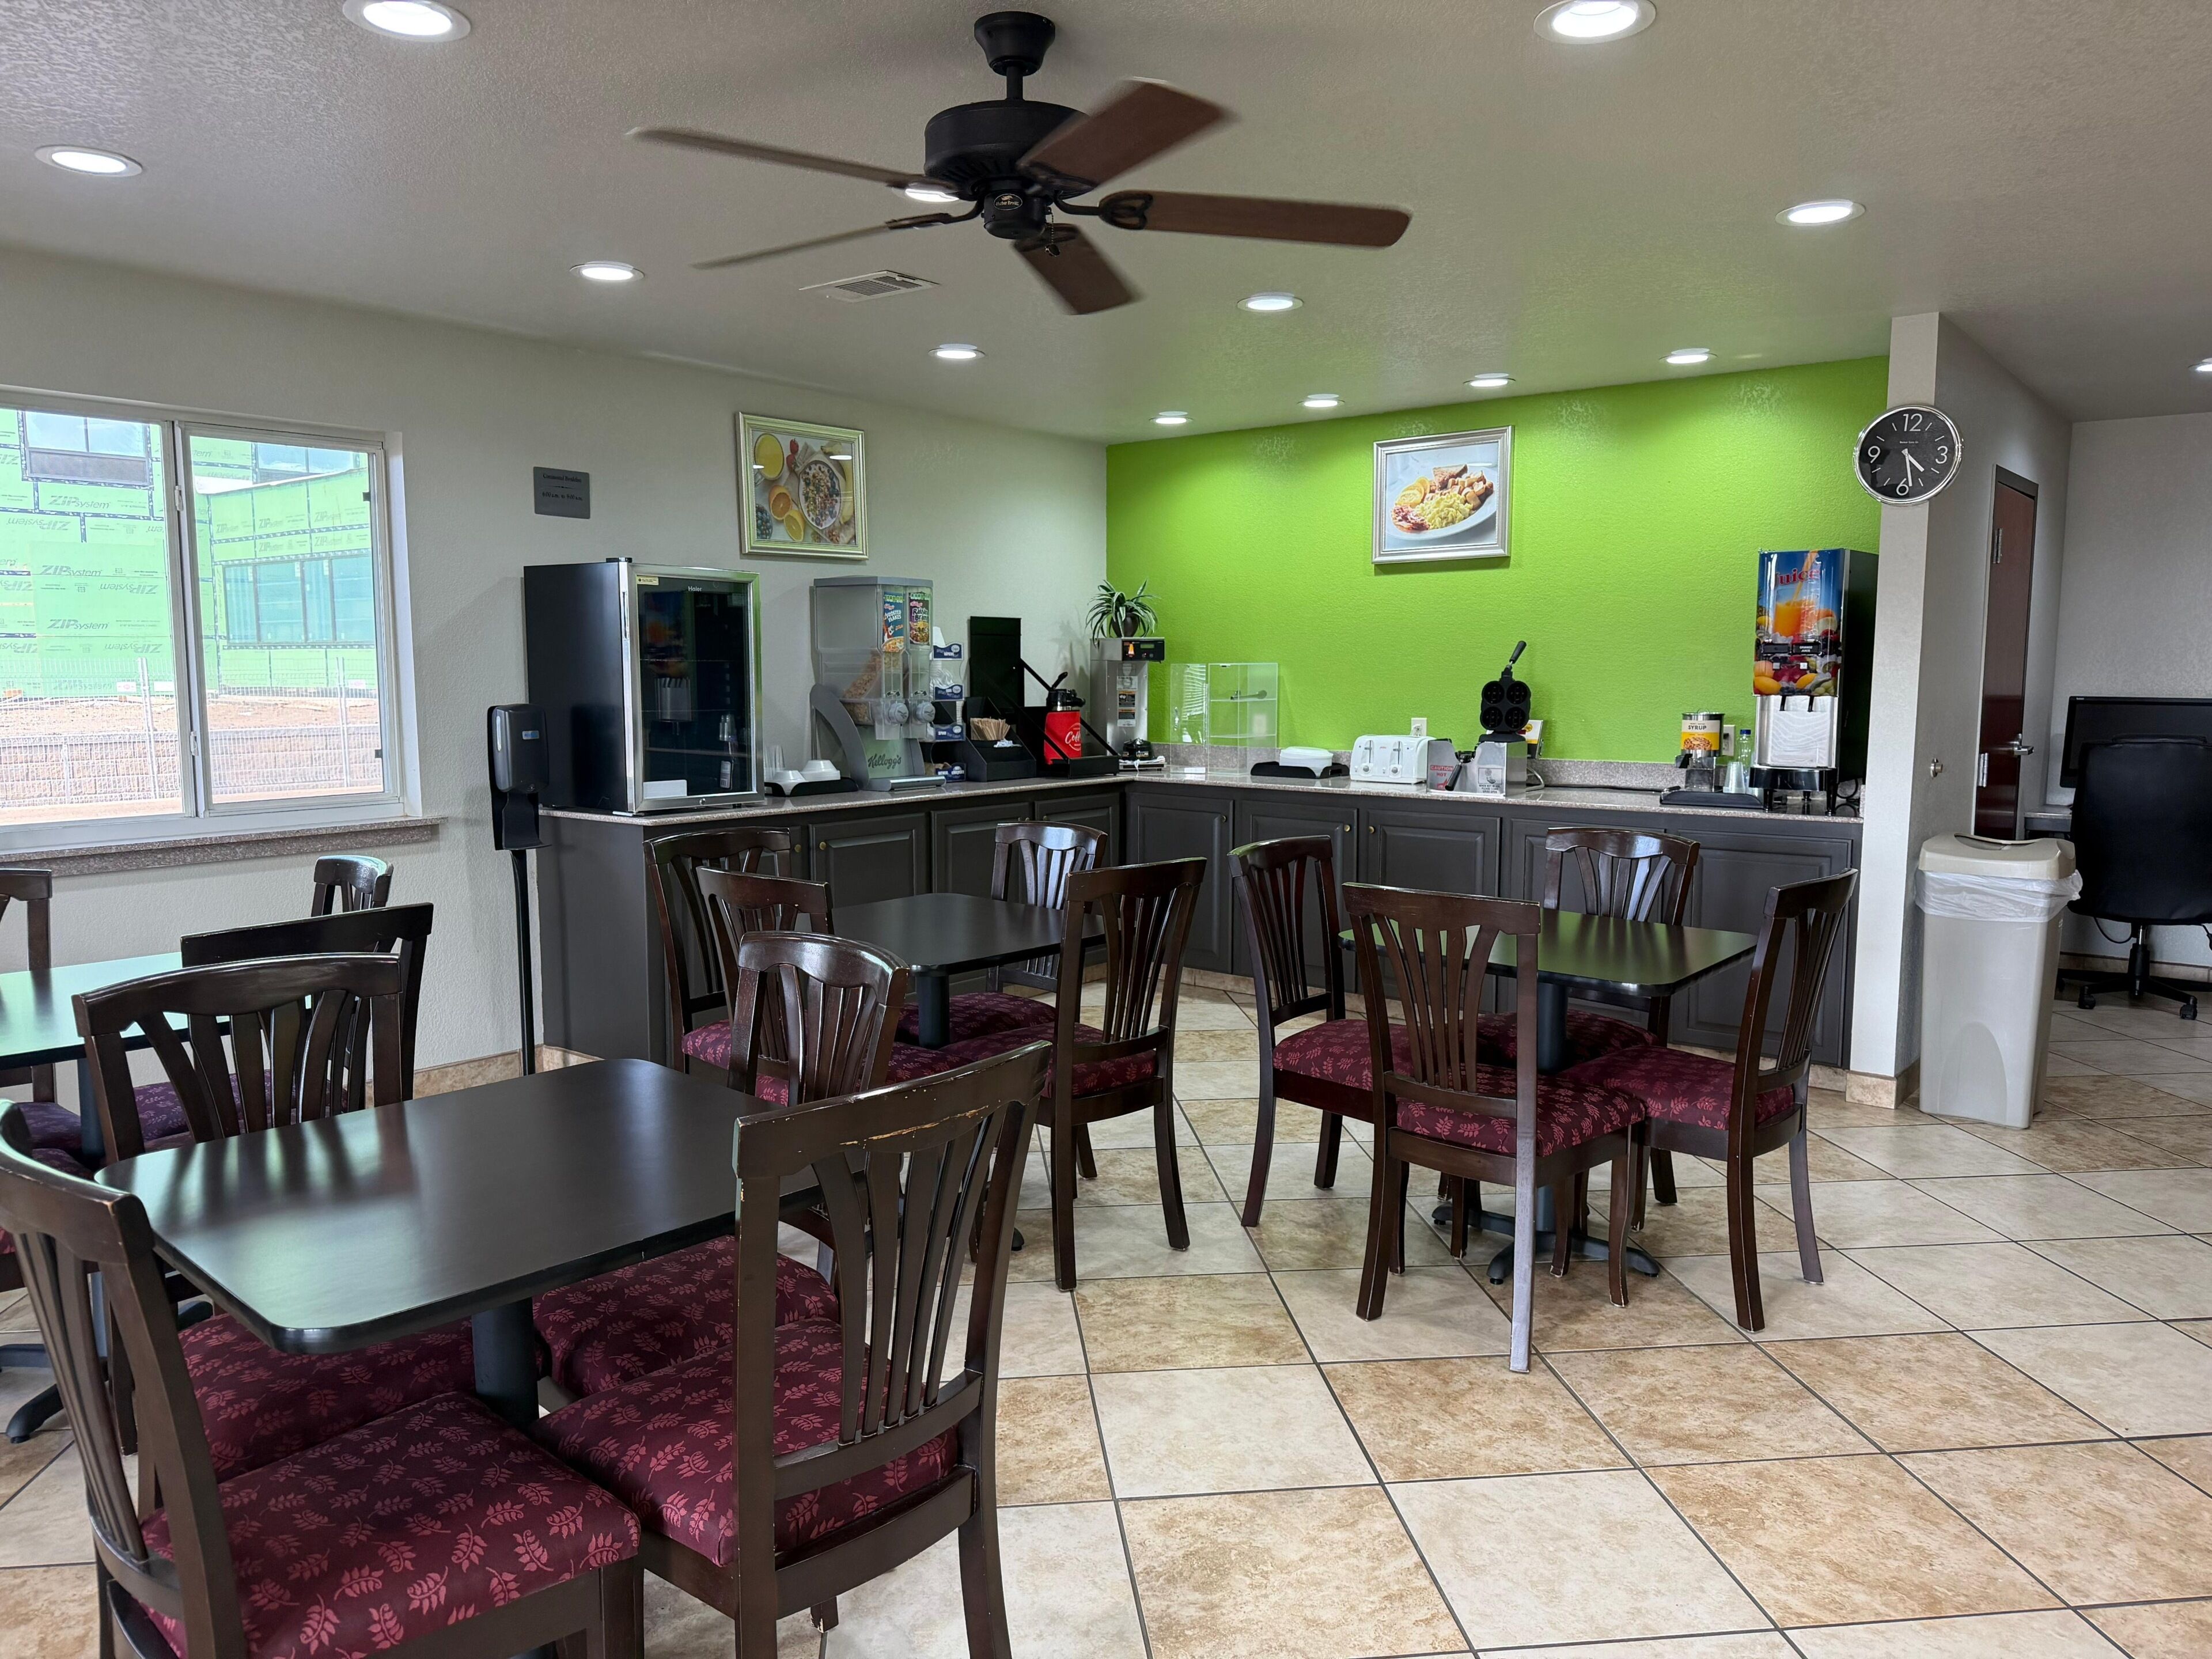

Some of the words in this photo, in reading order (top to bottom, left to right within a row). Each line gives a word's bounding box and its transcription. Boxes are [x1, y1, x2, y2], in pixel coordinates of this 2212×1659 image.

[1903, 414, 1923, 431] 12
[1868, 446, 1881, 464] 9
[1935, 445, 1948, 464] 3
[1896, 478, 1909, 496] 6
[868, 753, 902, 770] Kellogg's
